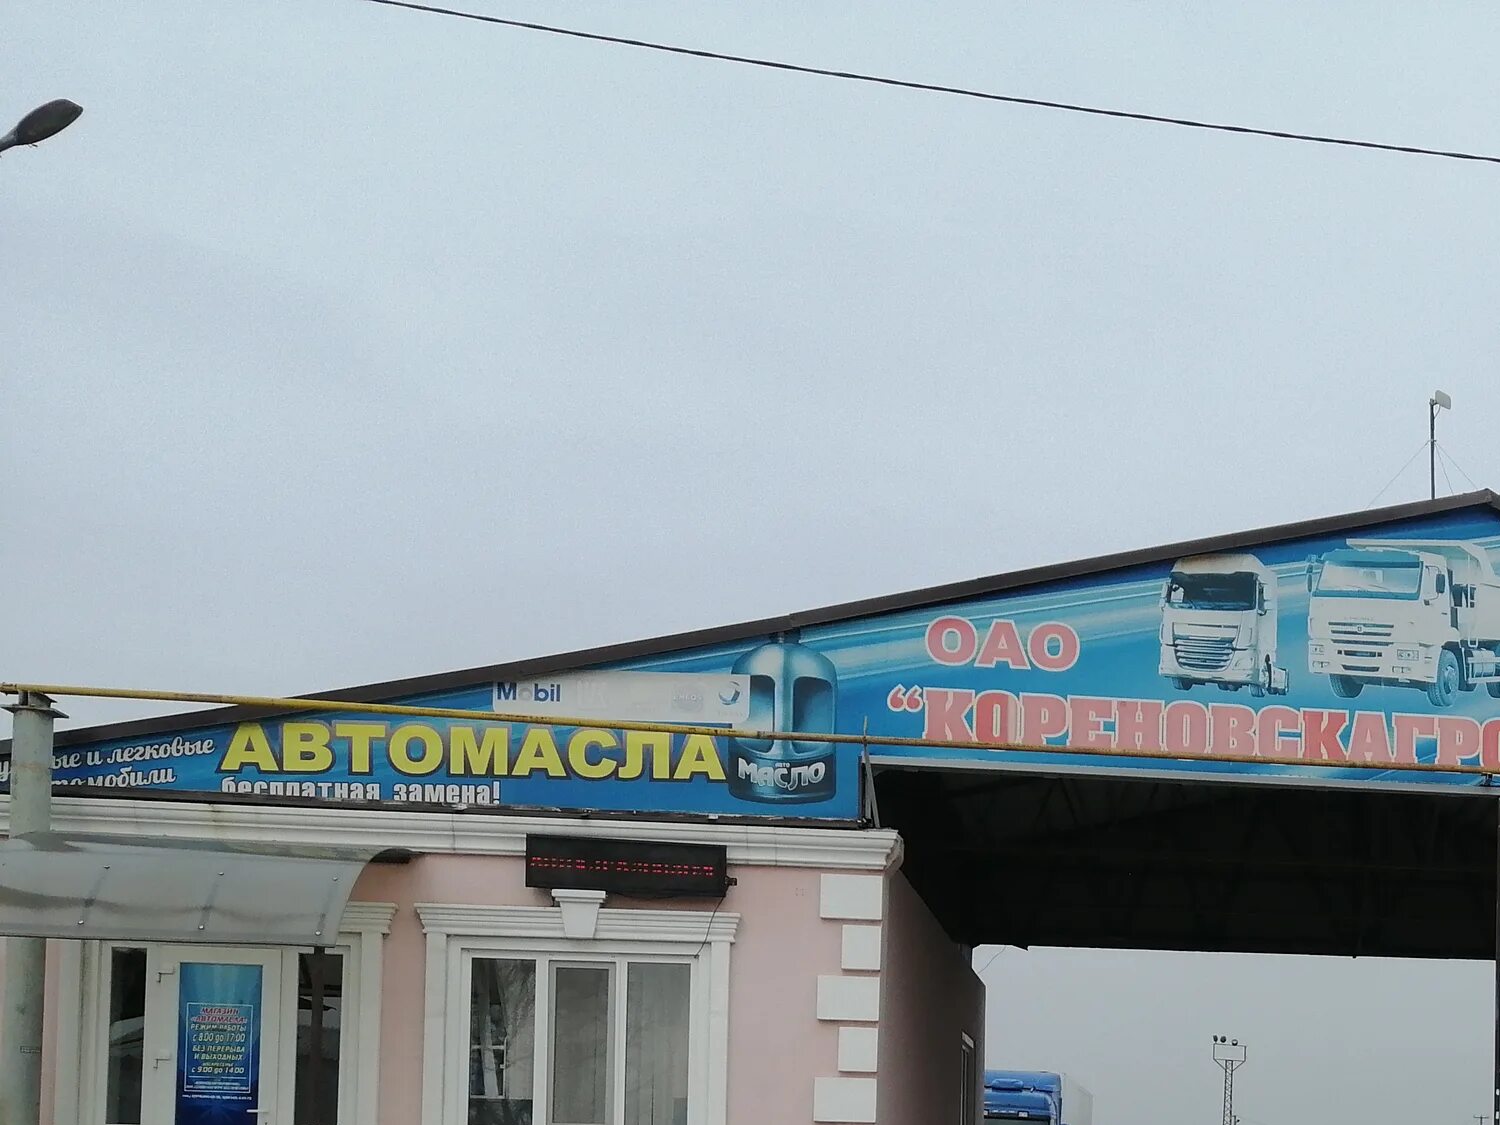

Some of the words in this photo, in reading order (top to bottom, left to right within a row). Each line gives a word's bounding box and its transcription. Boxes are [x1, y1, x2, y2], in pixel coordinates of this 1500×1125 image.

[926, 617, 1080, 671] ОАО
[107, 736, 215, 763] легковые
[217, 721, 731, 783] АВТОМАСЛА
[220, 776, 380, 801] бесплатная
[393, 780, 500, 805] замена!
